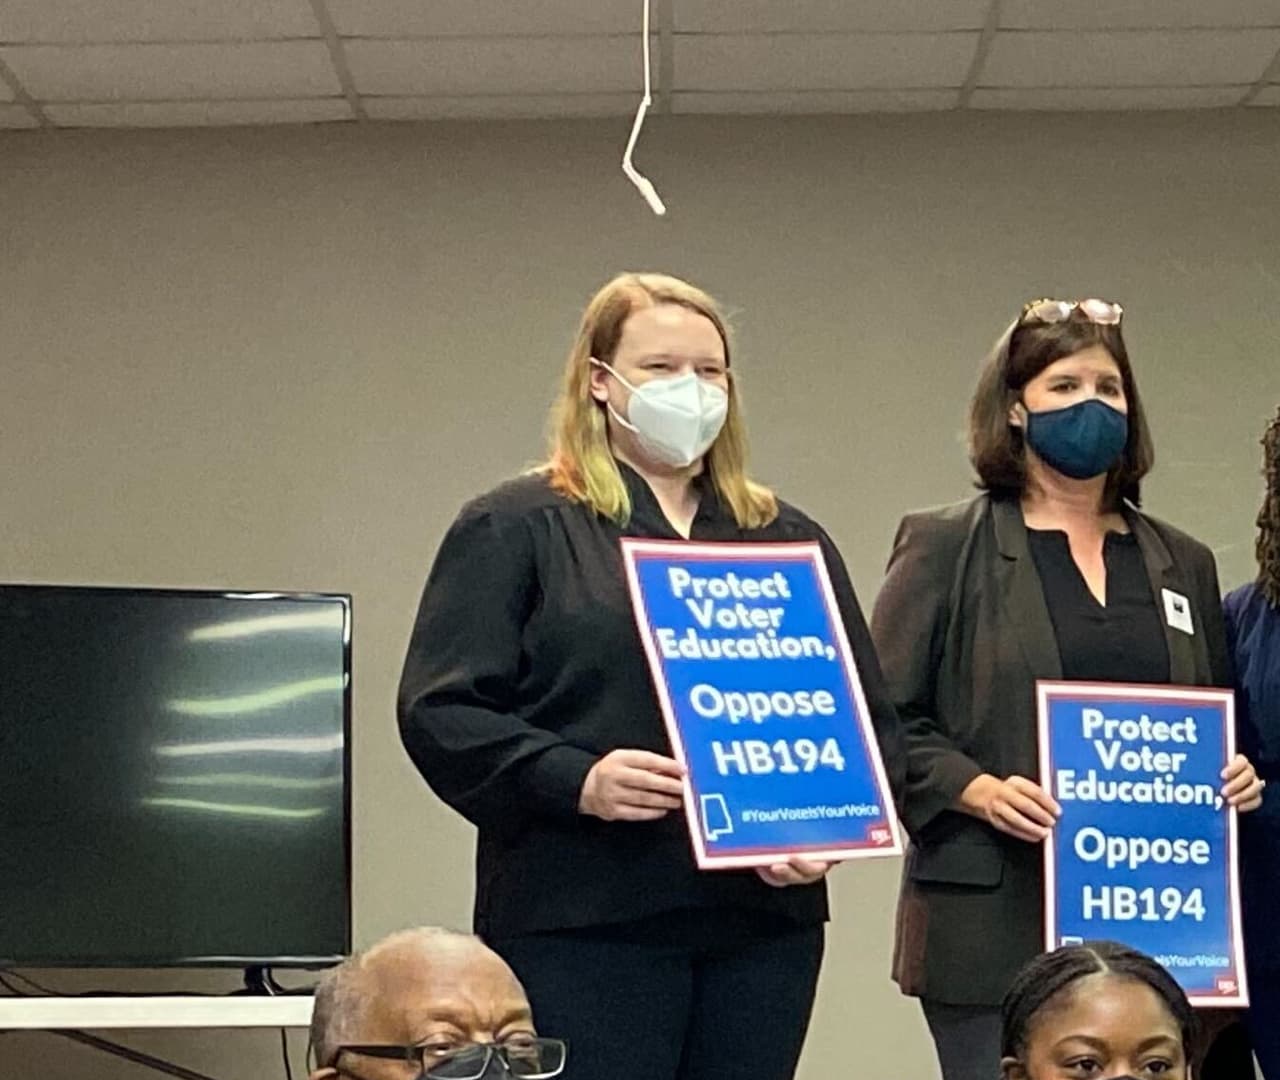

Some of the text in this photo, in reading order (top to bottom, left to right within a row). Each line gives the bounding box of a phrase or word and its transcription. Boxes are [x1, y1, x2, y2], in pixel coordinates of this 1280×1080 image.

[668, 567, 791, 598] Protect
[688, 598, 784, 630] Voter
[656, 629, 837, 662] Education,
[689, 684, 836, 724] Oppose
[1082, 709, 1198, 744] Protect
[712, 738, 846, 776] HB194
[1095, 741, 1186, 773] Voter
[1056, 770, 1223, 810] Education,
[1074, 827, 1210, 869] Oppose
[1083, 887, 1206, 922] HB194
